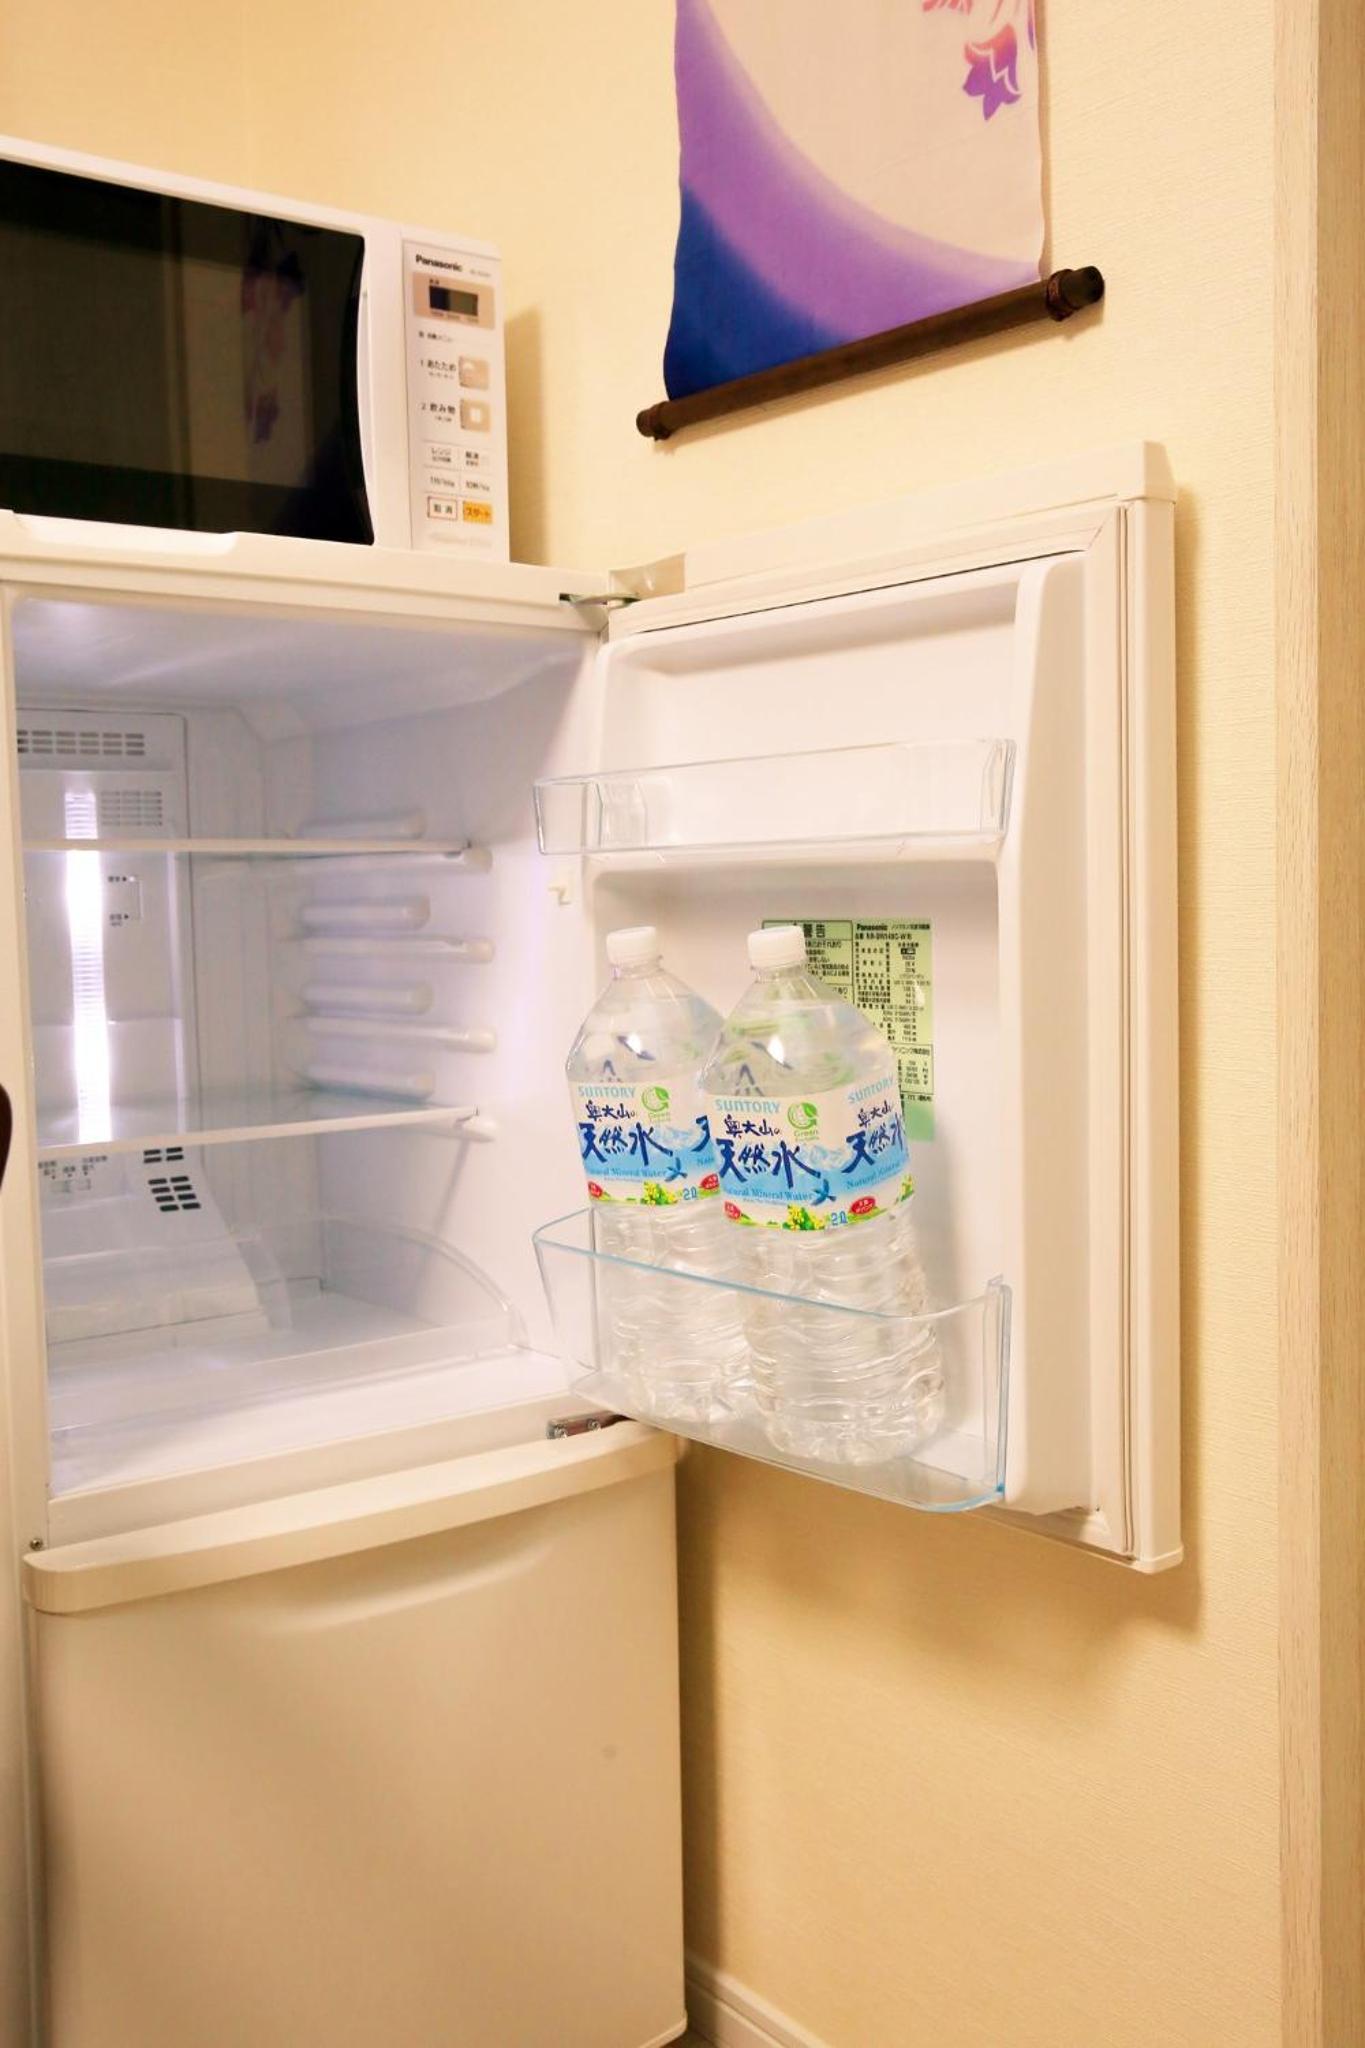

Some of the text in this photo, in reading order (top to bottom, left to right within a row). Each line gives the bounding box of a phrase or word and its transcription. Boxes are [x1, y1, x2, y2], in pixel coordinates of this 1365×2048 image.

[415, 254, 463, 272] Panasonic
[577, 1085, 636, 1099] SUNTORY
[714, 1098, 782, 1114] SUNTORY
[578, 1122, 674, 1167] 天然水
[715, 1138, 821, 1190] 天然水
